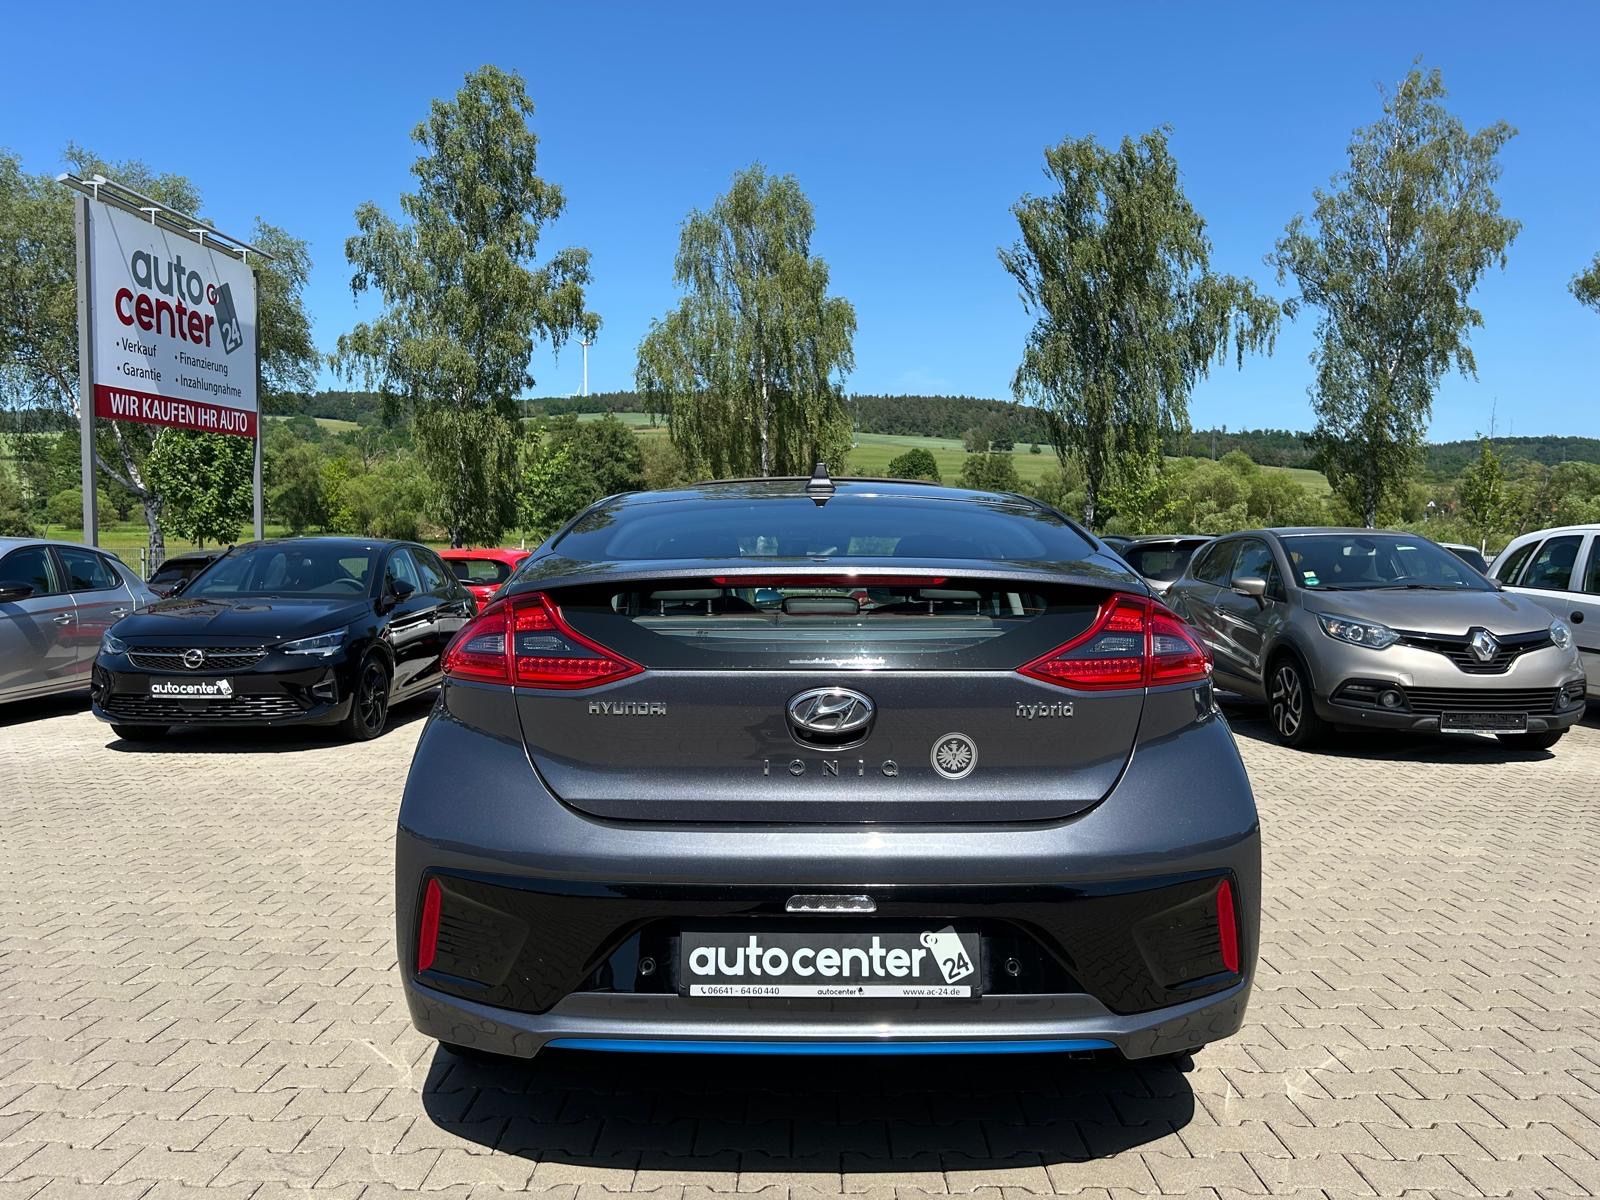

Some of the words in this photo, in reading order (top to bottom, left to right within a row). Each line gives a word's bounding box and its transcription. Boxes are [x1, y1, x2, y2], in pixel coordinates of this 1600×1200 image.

[131, 250, 204, 305] auto
[115, 287, 214, 347] center
[222, 319, 241, 349] 24
[122, 337, 157, 358] Verkauf
[123, 363, 162, 383] Garantie
[179, 351, 229, 377] Finanzierung
[180, 375, 242, 399] Inzahlungnahme
[110, 392, 140, 416] WIR
[142, 398, 195, 426] KAUFEN
[197, 408, 218, 429] IHR
[219, 412, 248, 433] AUTO
[588, 701, 667, 715] HYUNDAI
[1015, 701, 1074, 720] hybrid
[941, 951, 971, 981] 24
[902, 986, 961, 996] www.ac-24.de
